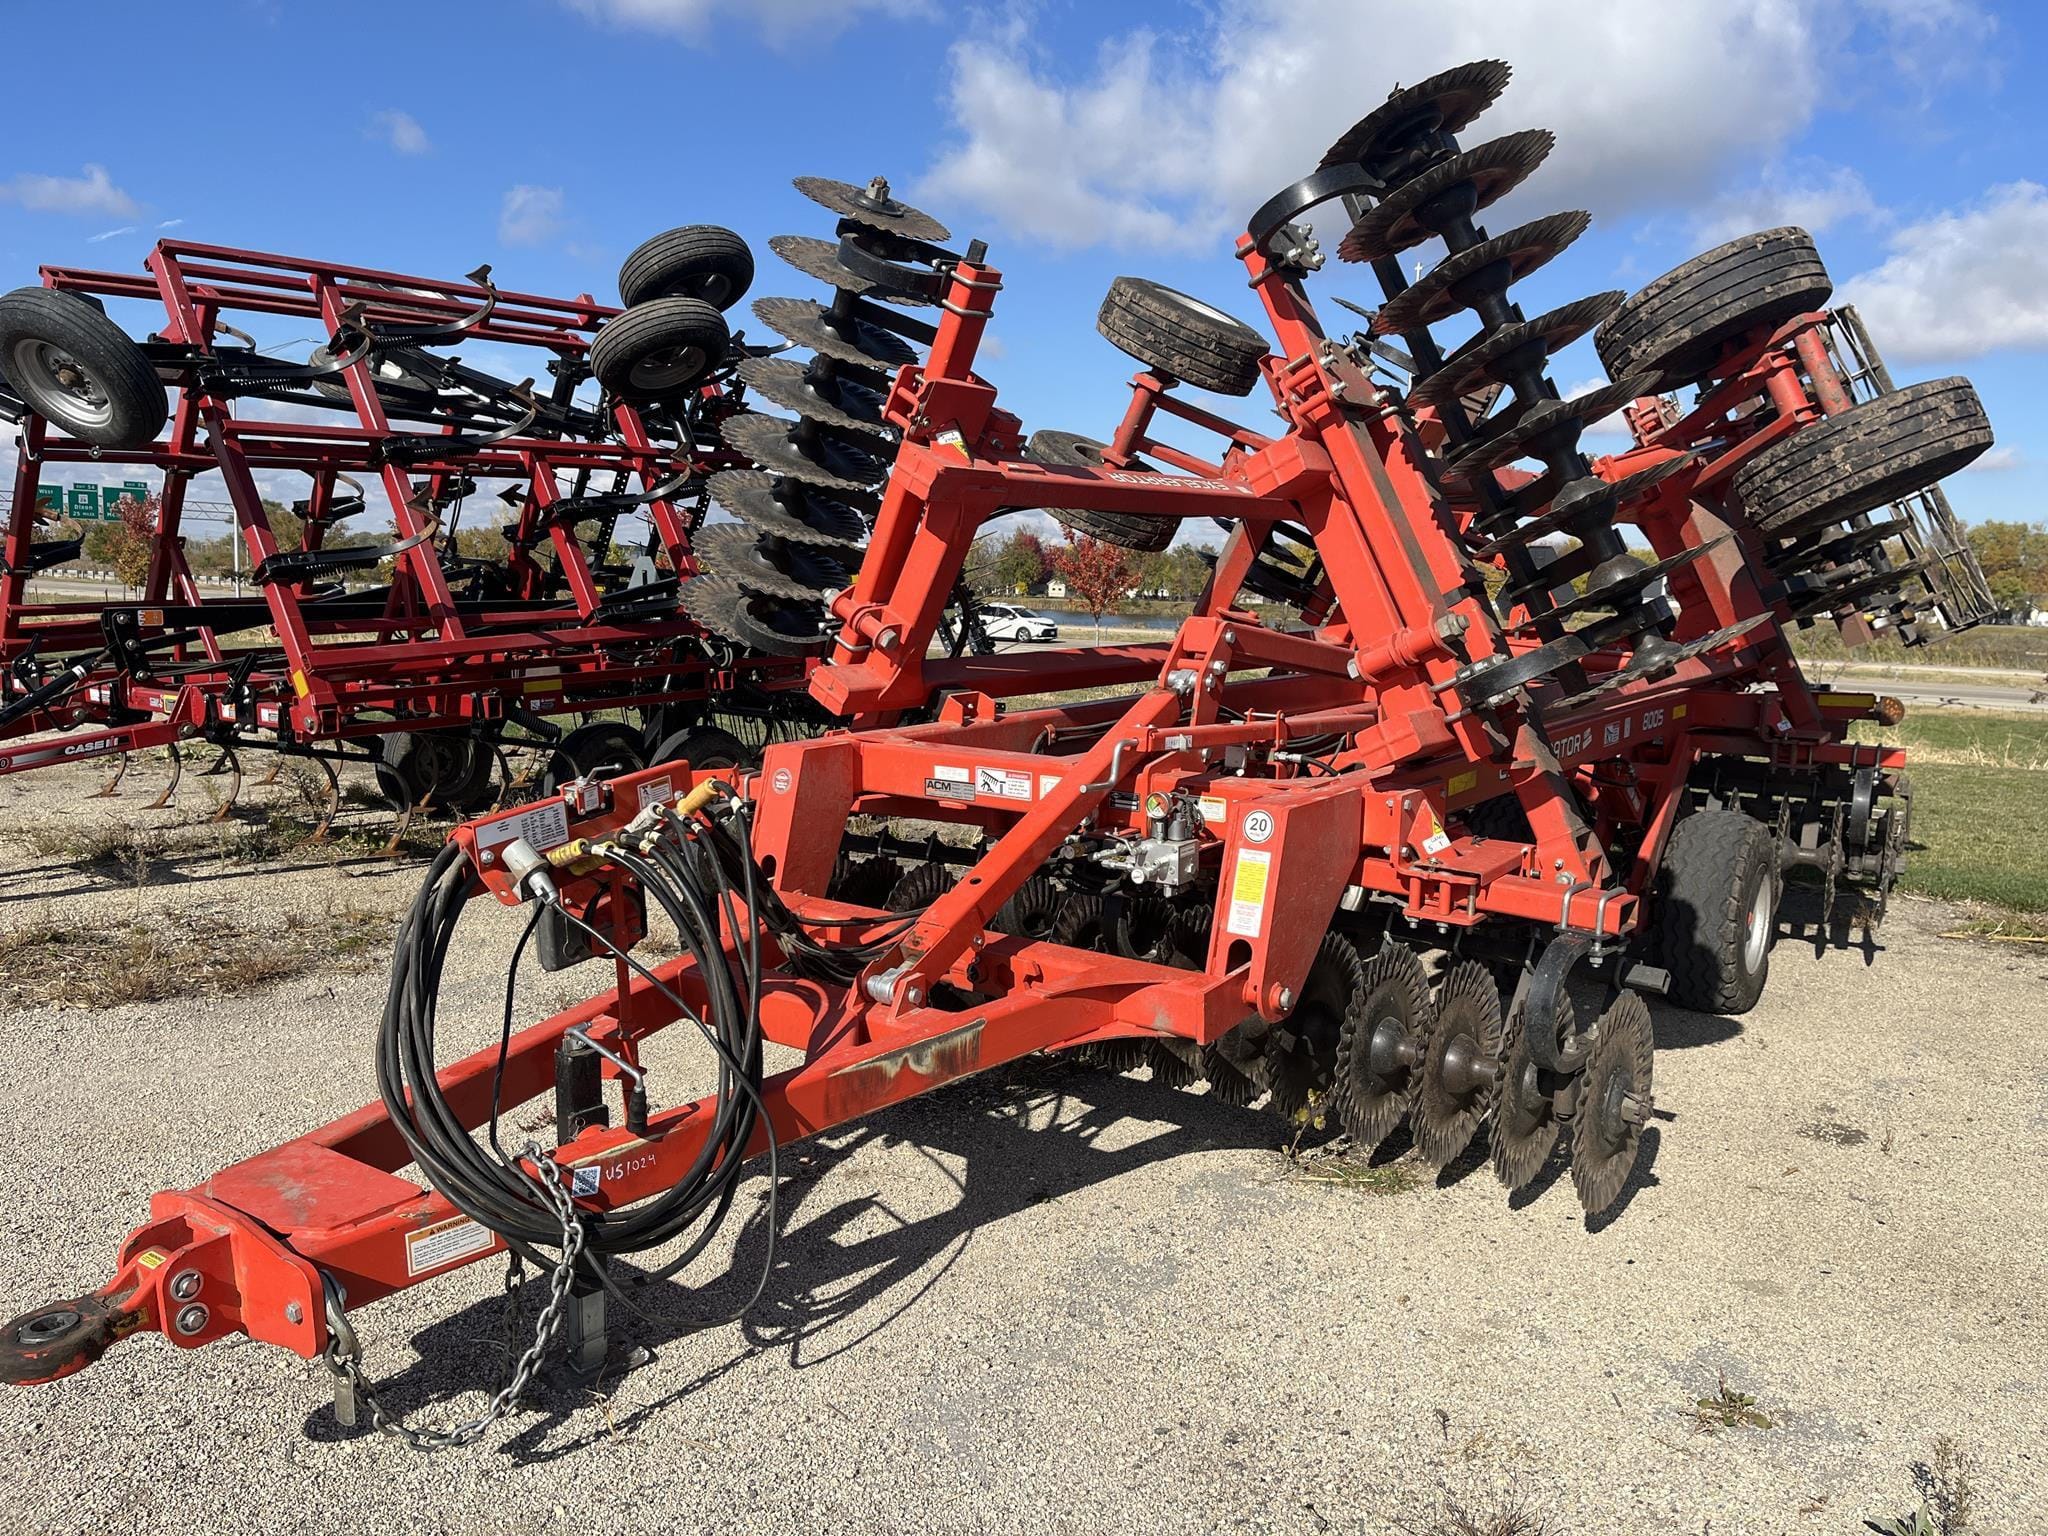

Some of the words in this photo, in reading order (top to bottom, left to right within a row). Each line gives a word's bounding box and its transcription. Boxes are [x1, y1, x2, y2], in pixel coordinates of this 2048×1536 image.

[1642, 709, 1664, 731] 8005
[64, 740, 105, 755] CASE
[926, 780, 952, 792] ACM
[1249, 817, 1268, 832] 20
[436, 1216, 471, 1233] WARNING
